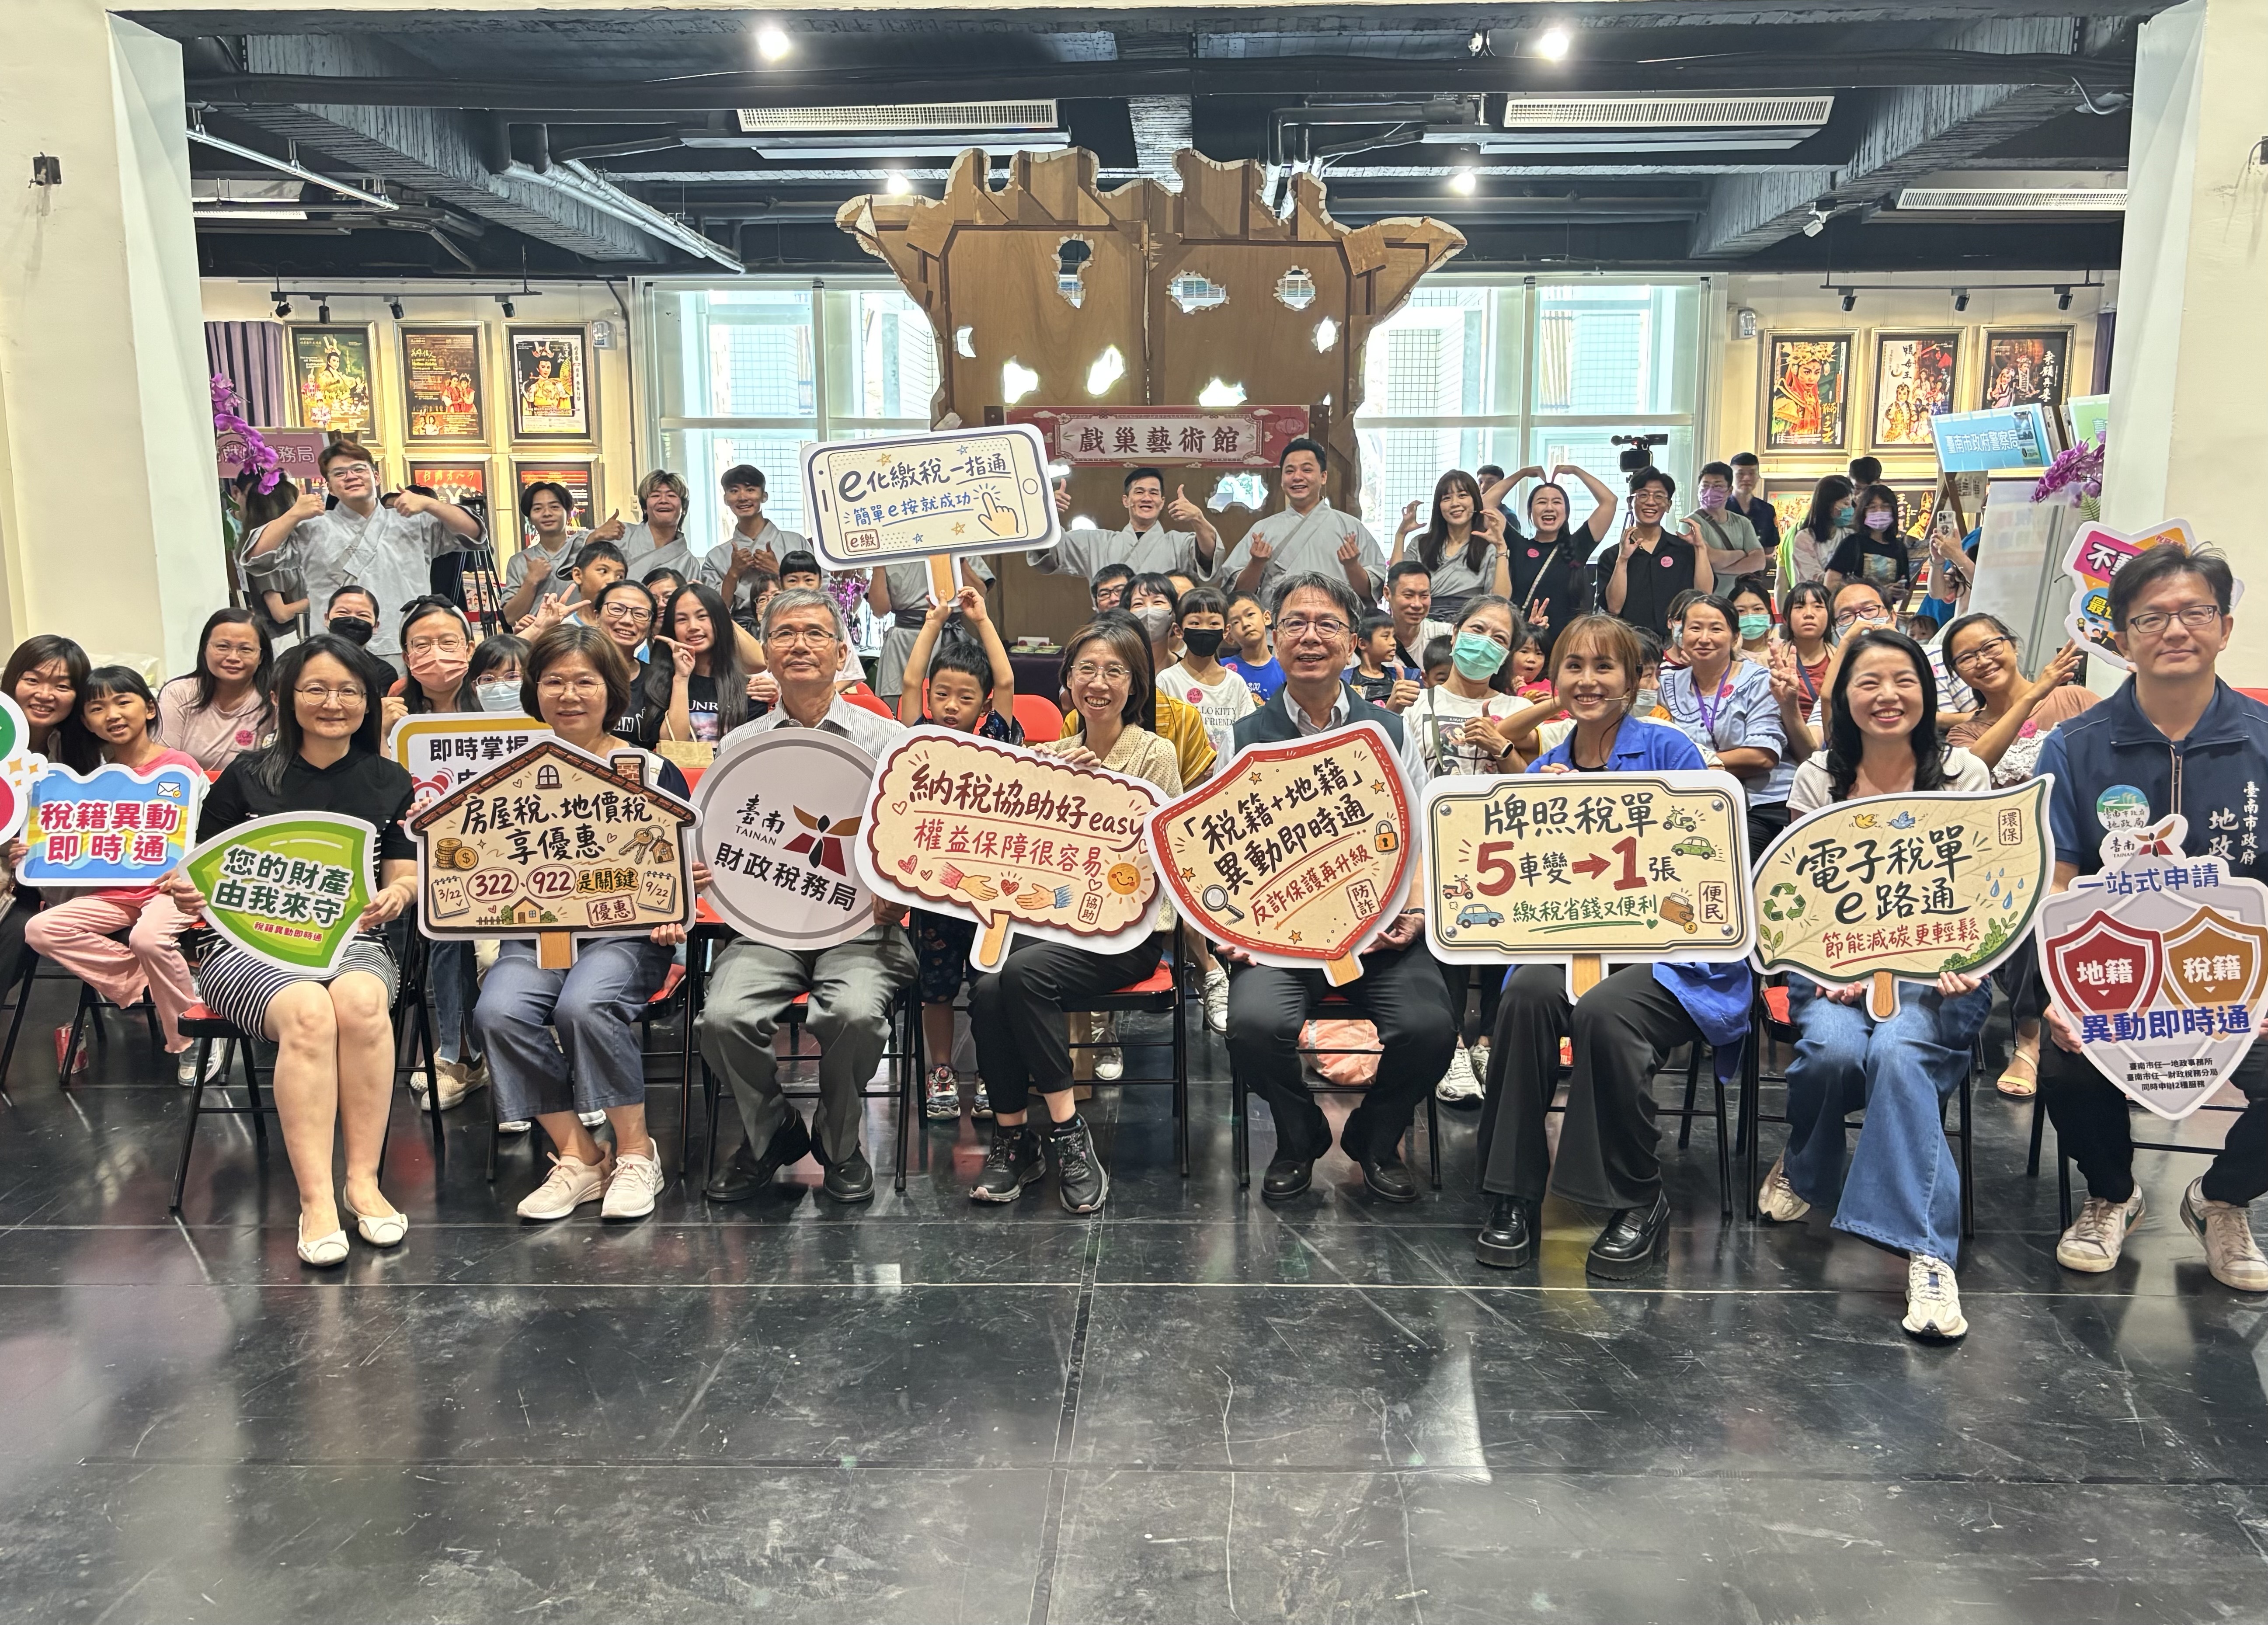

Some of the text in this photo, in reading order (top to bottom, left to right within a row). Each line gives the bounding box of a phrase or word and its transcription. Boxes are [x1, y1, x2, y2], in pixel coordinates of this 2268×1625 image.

[1078, 426, 1240, 455] 戲巢藝術館
[1944, 429, 2020, 455] 臺南市政府警察局
[853, 492, 971, 527] 簡單e按就成功
[850, 534, 877, 547] e繳
[2086, 595, 2113, 619] 最
[1215, 707, 1237, 716] KITTY
[41, 802, 177, 831] 稅籍異動
[736, 794, 785, 835] 臺南
[2002, 812, 2019, 841] 環保
[2106, 818, 2144, 829] 地政局
[2239, 781, 2260, 865] 臺南市政府
[48, 834, 164, 862] 即時通
[505, 824, 606, 865] 享優惠
[735, 825, 777, 846] TAINAN
[913, 818, 1102, 878] 權益保障很容易
[1214, 793, 1374, 896] 異動即時通
[2110, 836, 2135, 853] 臺南
[223, 847, 350, 896] 您的財產
[714, 842, 857, 912] 財政稅務局
[1250, 844, 1374, 927] 反詐保護再升級
[2077, 863, 2219, 896] 一站式申請
[215, 879, 341, 924] 由我來守
[438, 888, 463, 903] 3/22
[646, 880, 668, 898] 9/22
[1352, 885, 1375, 917] 防詐
[1703, 884, 1724, 920] 便民
[1835, 876, 1971, 925] e路通
[592, 901, 631, 922] 優惠
[1081, 895, 1098, 920] 協助
[254, 922, 323, 942] 稅籍異動即時通
[1822, 917, 1980, 959] 節能減碳更輕鬆
[2076, 958, 2133, 986] 地籍
[2182, 954, 2241, 983] 稅籍
[2081, 1004, 2251, 1045] 異動即時通
[2129, 1058, 2213, 1070] 臺南市任一地政事務所
